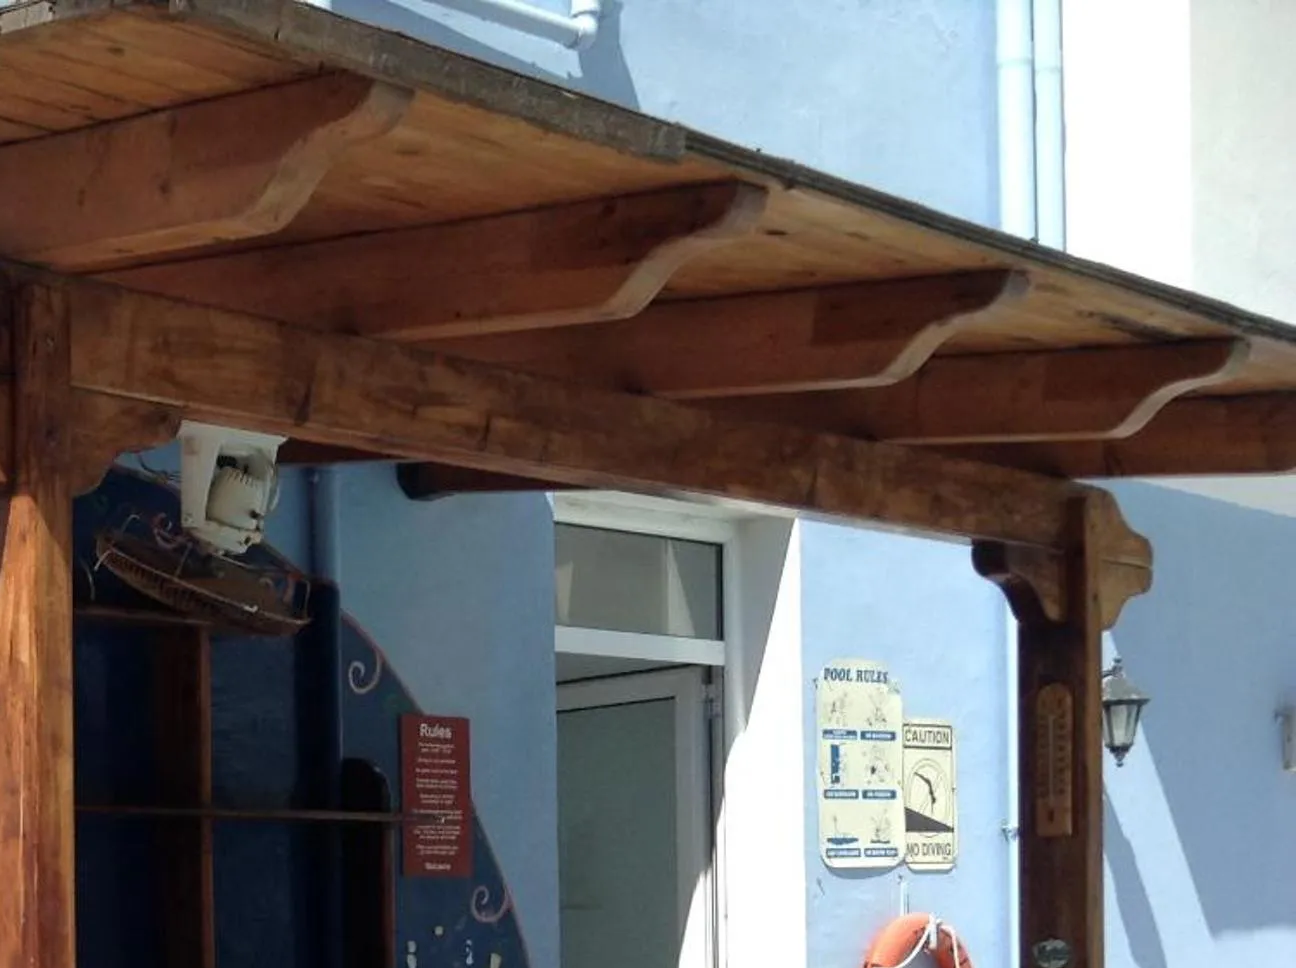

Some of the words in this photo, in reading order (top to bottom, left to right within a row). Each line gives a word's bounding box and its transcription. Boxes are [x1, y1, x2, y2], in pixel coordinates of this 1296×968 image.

[823, 667, 853, 682] POOL
[856, 669, 889, 684] RULES
[419, 723, 452, 739] Rules
[904, 726, 950, 744] CAUTION
[906, 842, 920, 857] NO
[922, 842, 952, 857] DIVING
